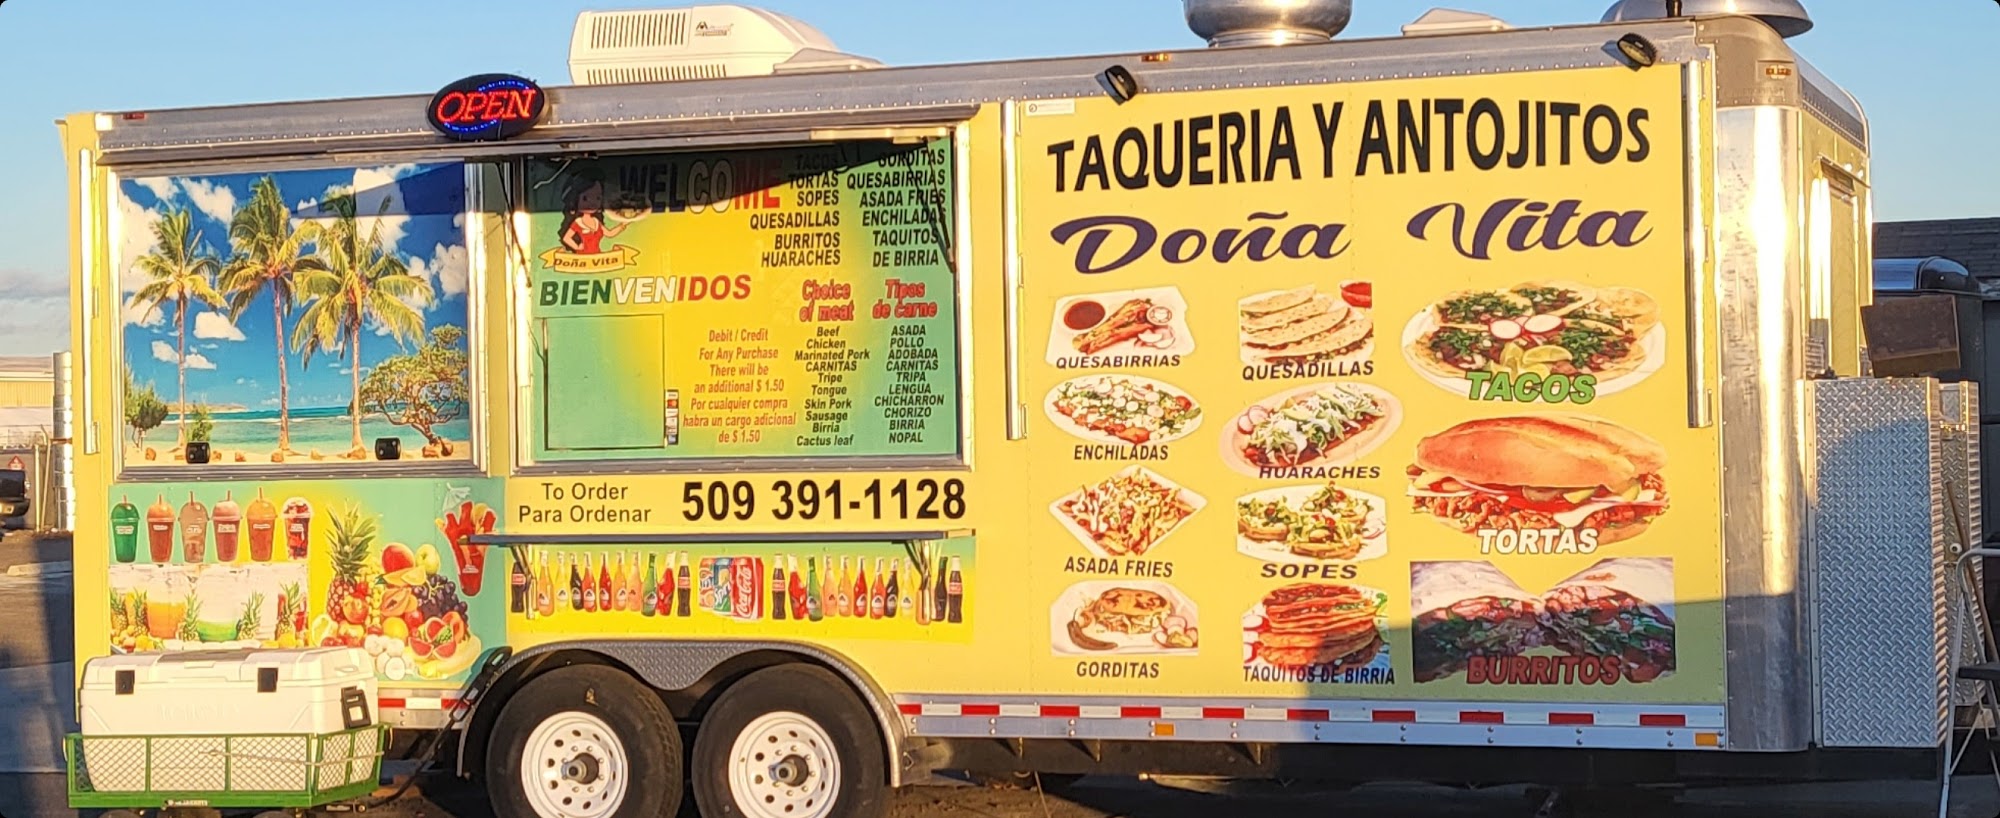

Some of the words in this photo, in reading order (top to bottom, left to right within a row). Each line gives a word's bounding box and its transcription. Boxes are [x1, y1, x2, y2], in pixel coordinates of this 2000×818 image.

[437, 89, 536, 123] OPEN
[1047, 106, 1301, 193] TAQUERIA
[1312, 101, 1345, 178] Y
[1355, 98, 1652, 177] ANTOJITOS
[619, 159, 781, 214] WELCOME
[788, 171, 839, 190] TORTAS
[847, 169, 945, 190] QUESABIRRIAS
[797, 190, 839, 207] SOPES
[860, 191, 903, 208] ASADA
[908, 188, 946, 206] FRIES
[750, 211, 840, 230] QUESADILLAS
[862, 208, 946, 227] ENCHILADAS
[775, 232, 840, 250] BURRITOS
[873, 228, 939, 247] TAQUITOS
[1050, 211, 1352, 275] Doña
[1406, 197, 1655, 261] Vita
[553, 257, 586, 268] Doña
[592, 256, 619, 267] Vita
[762, 249, 841, 268] HUARACHES
[873, 251, 890, 267] DE
[894, 250, 939, 266] BIRRIA
[539, 274, 751, 306] BIENVENIDOS
[802, 279, 851, 301] Choice
[885, 278, 925, 299] Tipos
[800, 300, 815, 322] of
[818, 300, 855, 322] meat
[872, 299, 891, 319] de
[709, 329, 733, 342] Debit
[740, 328, 768, 341] Credit
[817, 326, 840, 337] Beef
[891, 325, 926, 336] ASADA
[806, 338, 846, 349] Chicken
[890, 337, 924, 348] POLLO
[699, 347, 714, 360] For
[716, 347, 733, 363] Any
[736, 346, 779, 360] Purchase
[795, 350, 844, 361] Marinated
[847, 349, 870, 360] Pork
[888, 348, 938, 360] ADOBADA
[1056, 354, 1181, 369] QUESABIRRIAS
[710, 363, 736, 377] There
[738, 363, 755, 376] will
[757, 363, 769, 376] be
[806, 360, 857, 372] CARNITAS
[886, 360, 938, 371] CARNITAS
[1242, 360, 1374, 381] QUESADILLAS
[818, 372, 842, 385] Tripe
[896, 371, 926, 382] TRIPA
[694, 383, 706, 394] an
[708, 380, 754, 393] additional
[756, 379, 762, 393] $
[765, 379, 785, 393] 1.50
[811, 385, 847, 398] Tongue
[888, 384, 931, 395] LENGUA
[1465, 371, 1597, 404] TACOS
[691, 398, 706, 411] Por
[708, 397, 751, 413] cualquier
[753, 398, 788, 412] compra
[804, 398, 826, 410] Skin
[829, 399, 852, 410] Pork
[874, 394, 944, 407] CHICHARRON
[683, 413, 709, 427] habra
[712, 416, 722, 427] un
[725, 415, 752, 430] cargo
[754, 412, 797, 426] adicional
[805, 410, 848, 423] Sausage
[884, 407, 932, 418] CHORIZO
[812, 422, 840, 433] Birria
[889, 419, 925, 430] BIRRIA
[718, 430, 730, 443] de
[732, 429, 738, 443] $
[741, 429, 760, 443] 1.50
[796, 435, 831, 446] Cactus
[834, 434, 854, 446] leaf
[888, 432, 923, 443] NOPAL
[1074, 444, 1169, 461] ENCHILADAS
[1258, 465, 1381, 479] HUARACHES
[541, 482, 565, 501] To
[571, 482, 628, 501] Order
[682, 479, 755, 522] 509
[771, 478, 966, 521] 391-1128
[519, 505, 566, 523] Para
[569, 505, 651, 523] Ordenar
[1476, 528, 1599, 555] TORTAS
[1064, 556, 1119, 575] ASADA
[1125, 559, 1173, 578] FRIES
[1260, 564, 1357, 579] SOPES
[1076, 661, 1160, 679] GORDITAS
[1243, 665, 1315, 684] TAQUITOS
[1316, 666, 1340, 684] DE
[1344, 667, 1395, 685] BIRRIA
[1466, 655, 1621, 685] BURRITOS
